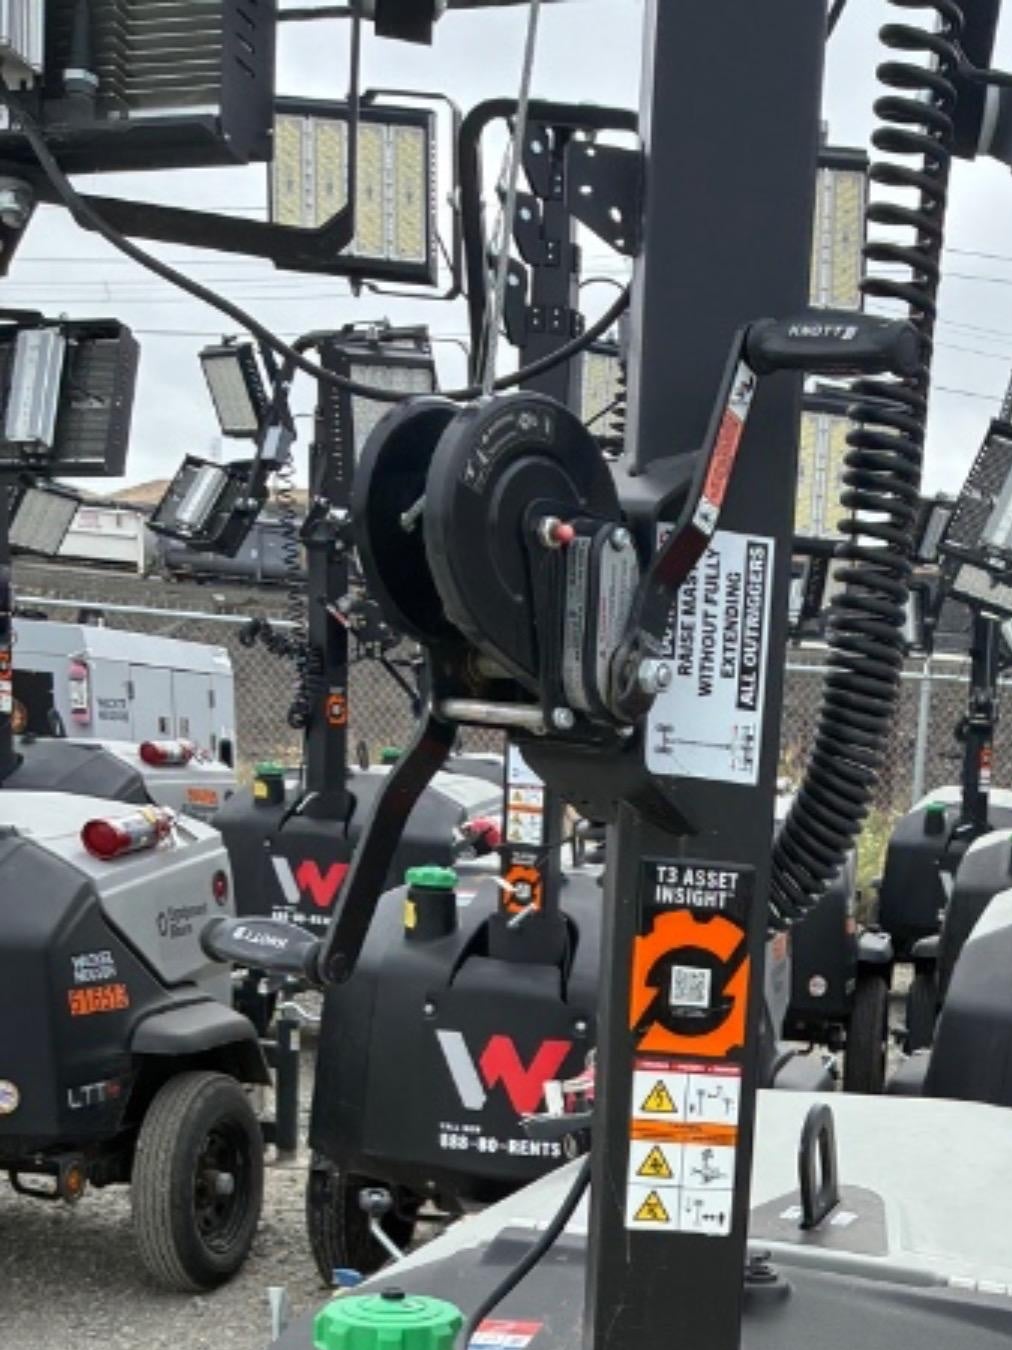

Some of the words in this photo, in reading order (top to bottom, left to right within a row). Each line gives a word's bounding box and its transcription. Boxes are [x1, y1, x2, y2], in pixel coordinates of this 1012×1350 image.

[680, 564, 699, 616] MAS
[702, 548, 721, 607] FULLY
[720, 572, 742, 679] EXTENDING
[743, 545, 765, 667] OUTRIGGERS
[677, 621, 697, 677] RAISE
[698, 612, 718, 697] WITHOUT
[740, 671, 757, 706] ALL
[655, 885, 729, 909] INSIGHT
[656, 865, 679, 884] T3
[682, 868, 739, 890] ASSET
